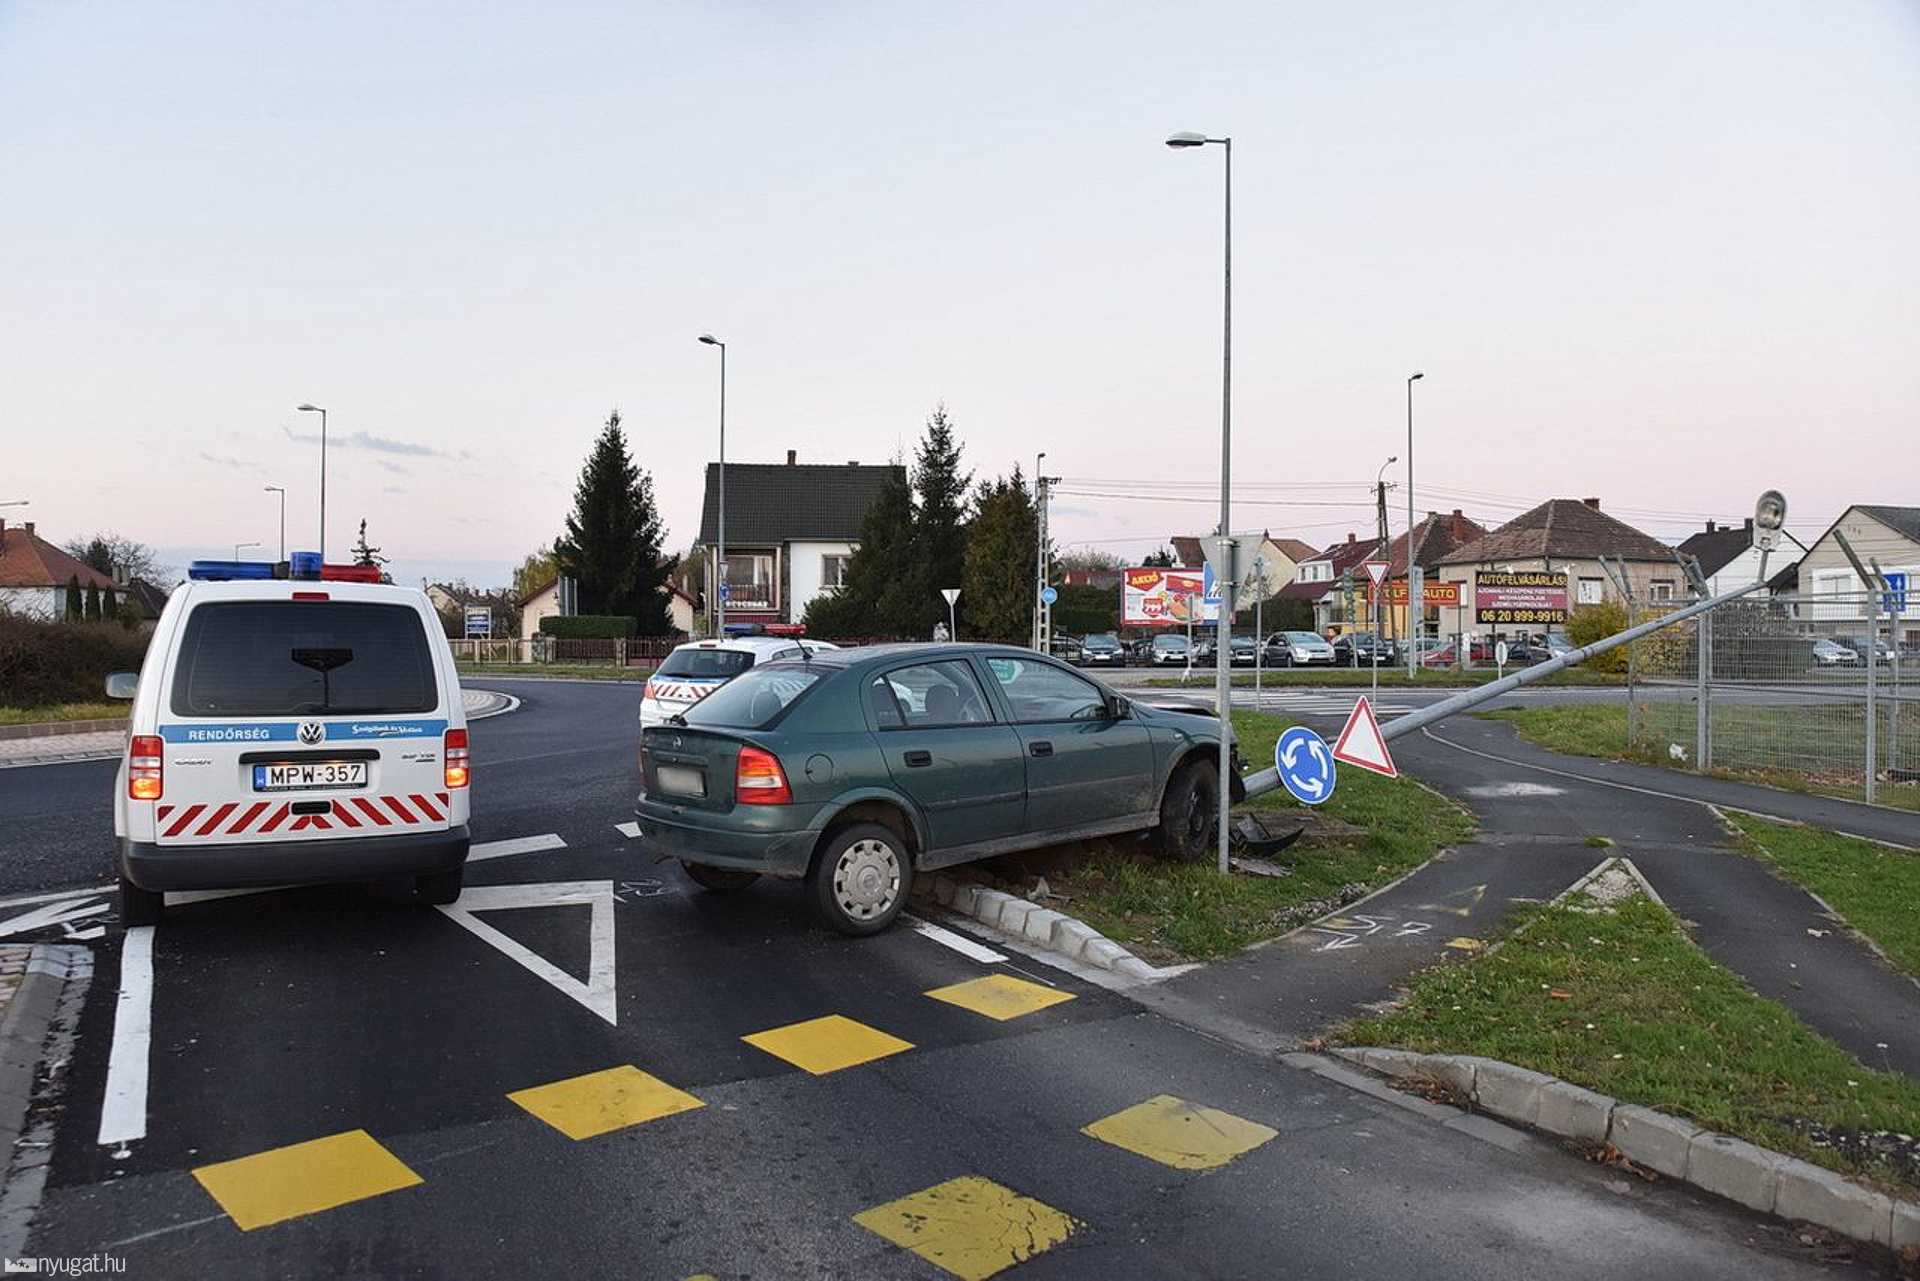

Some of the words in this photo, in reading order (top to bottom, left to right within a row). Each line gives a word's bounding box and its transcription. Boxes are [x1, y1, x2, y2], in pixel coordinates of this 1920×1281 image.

[1132, 571, 1158, 585] AKCIÓ
[1423, 588, 1455, 599] AUTO
[1481, 610, 1496, 622] 06
[1498, 610, 1512, 622] 20
[188, 727, 271, 741] RENDŐRSÉG
[270, 764, 362, 784] MPW-357
